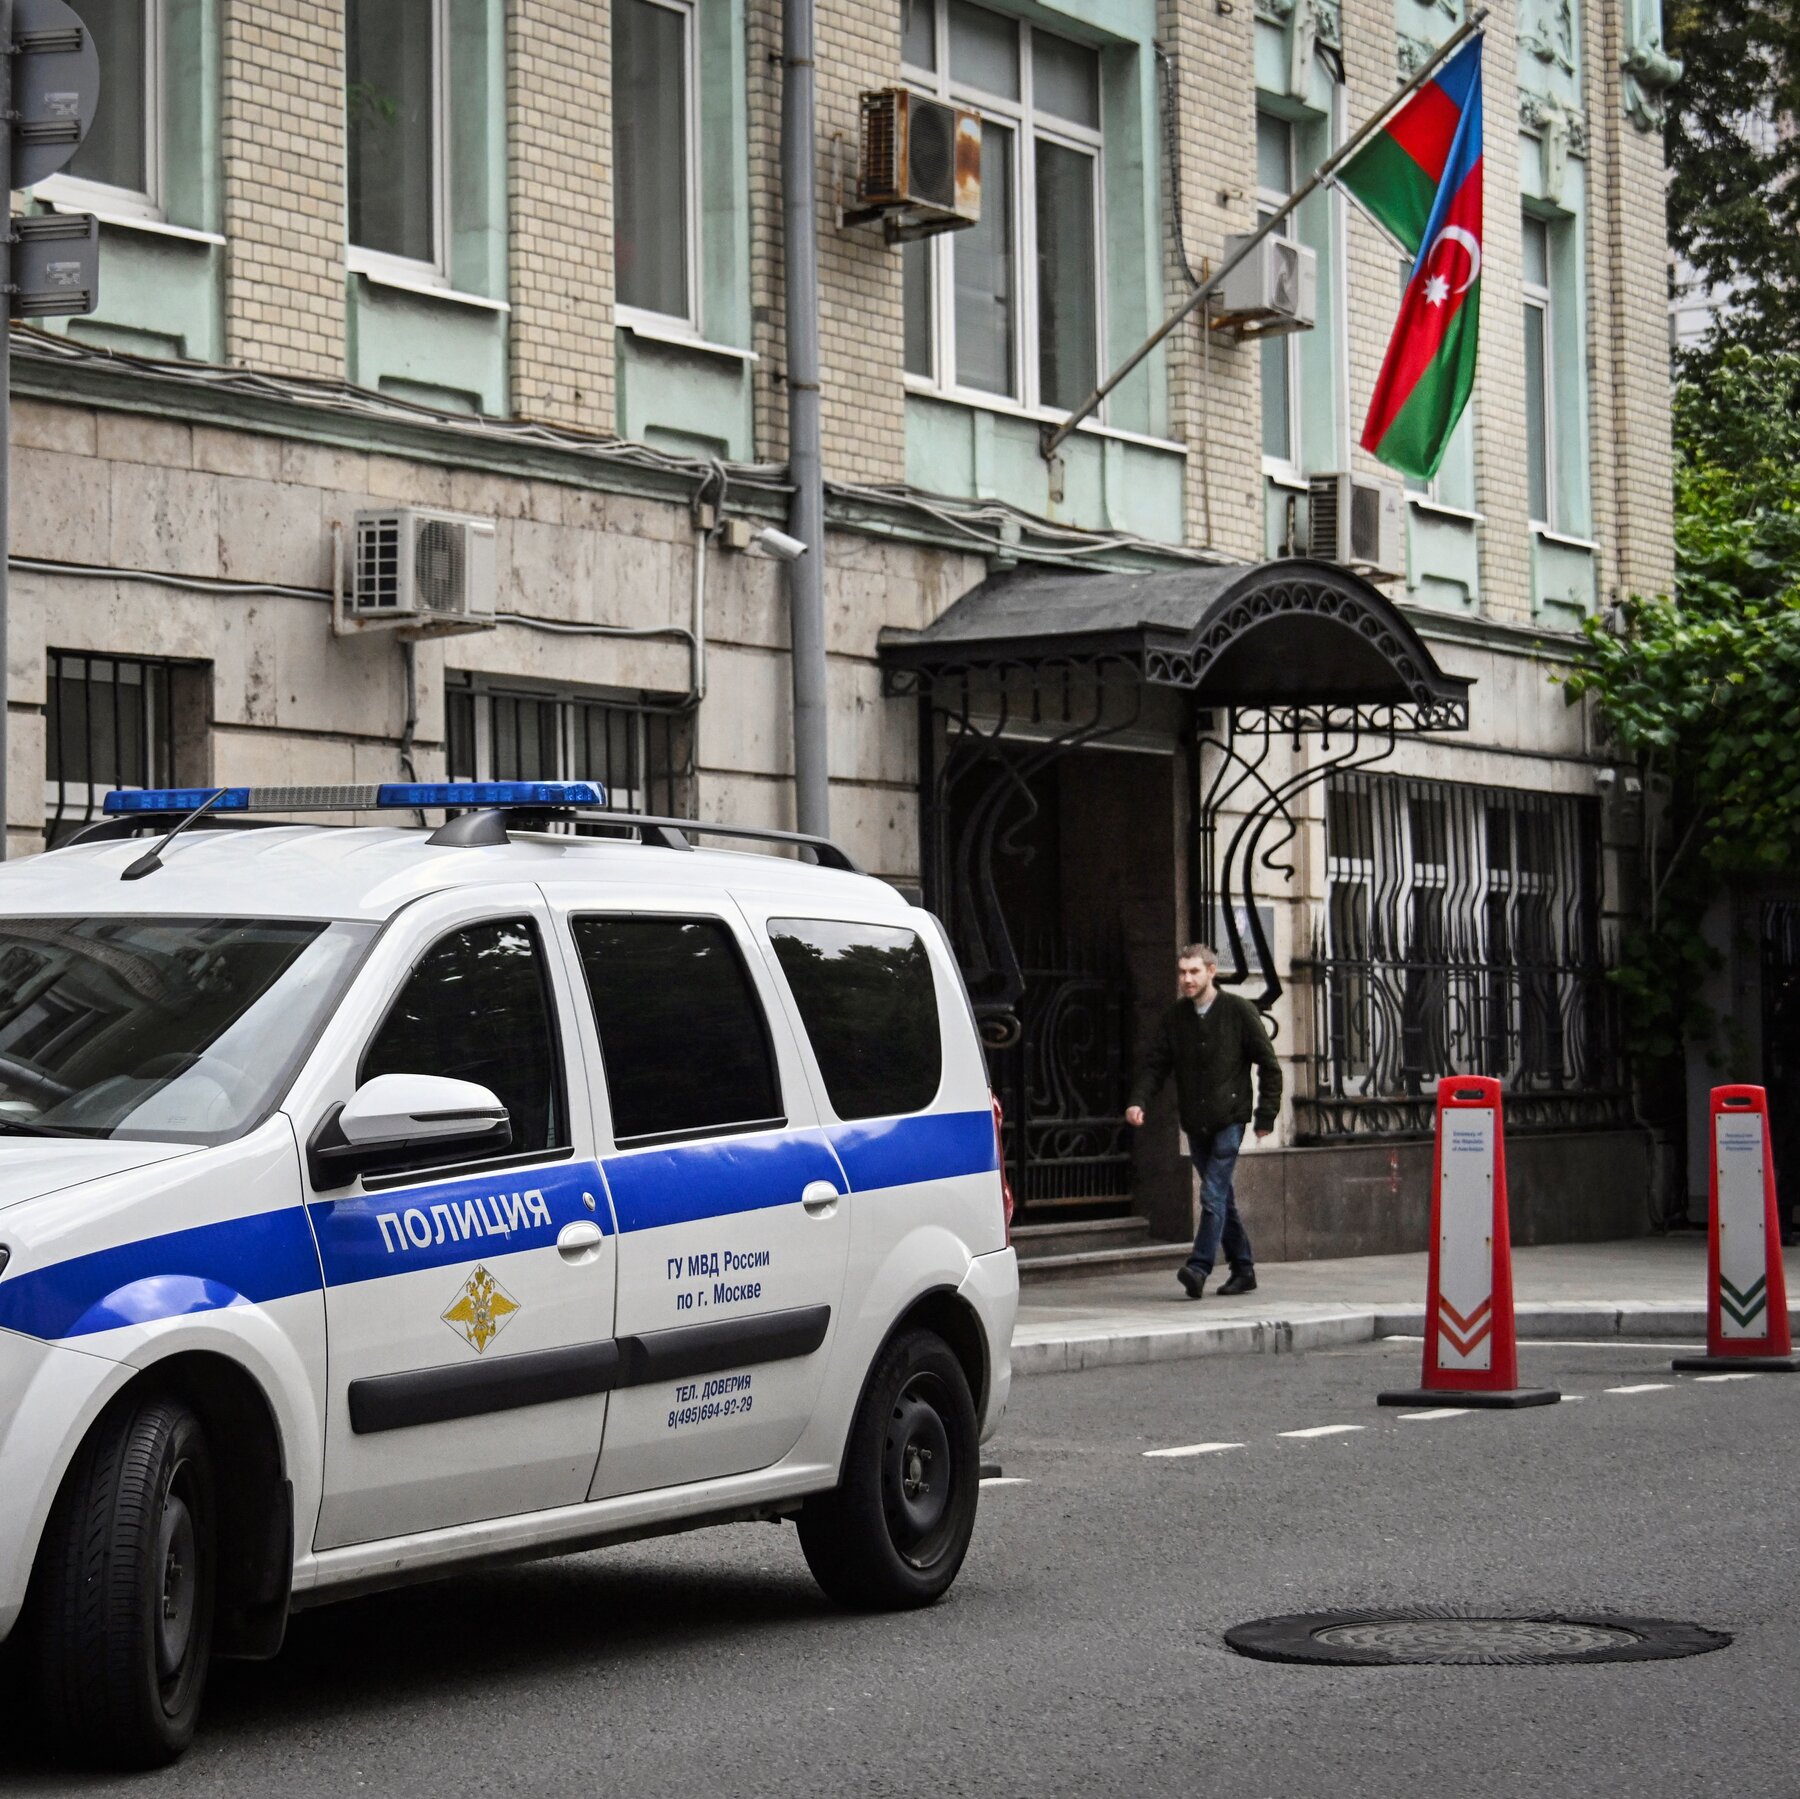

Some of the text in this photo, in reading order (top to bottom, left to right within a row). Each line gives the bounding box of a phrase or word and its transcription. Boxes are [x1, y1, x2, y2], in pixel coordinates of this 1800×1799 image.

[375, 1189, 553, 1253] ПОЛИЦИЯ
[667, 1250, 770, 1280] ГУ МВД России
[677, 1282, 762, 1311] по г. Москве
[675, 1374, 752, 1403] ТЕЛ. ДОВЕРИЯ
[667, 1395, 753, 1429] 8(495)694-92-29
